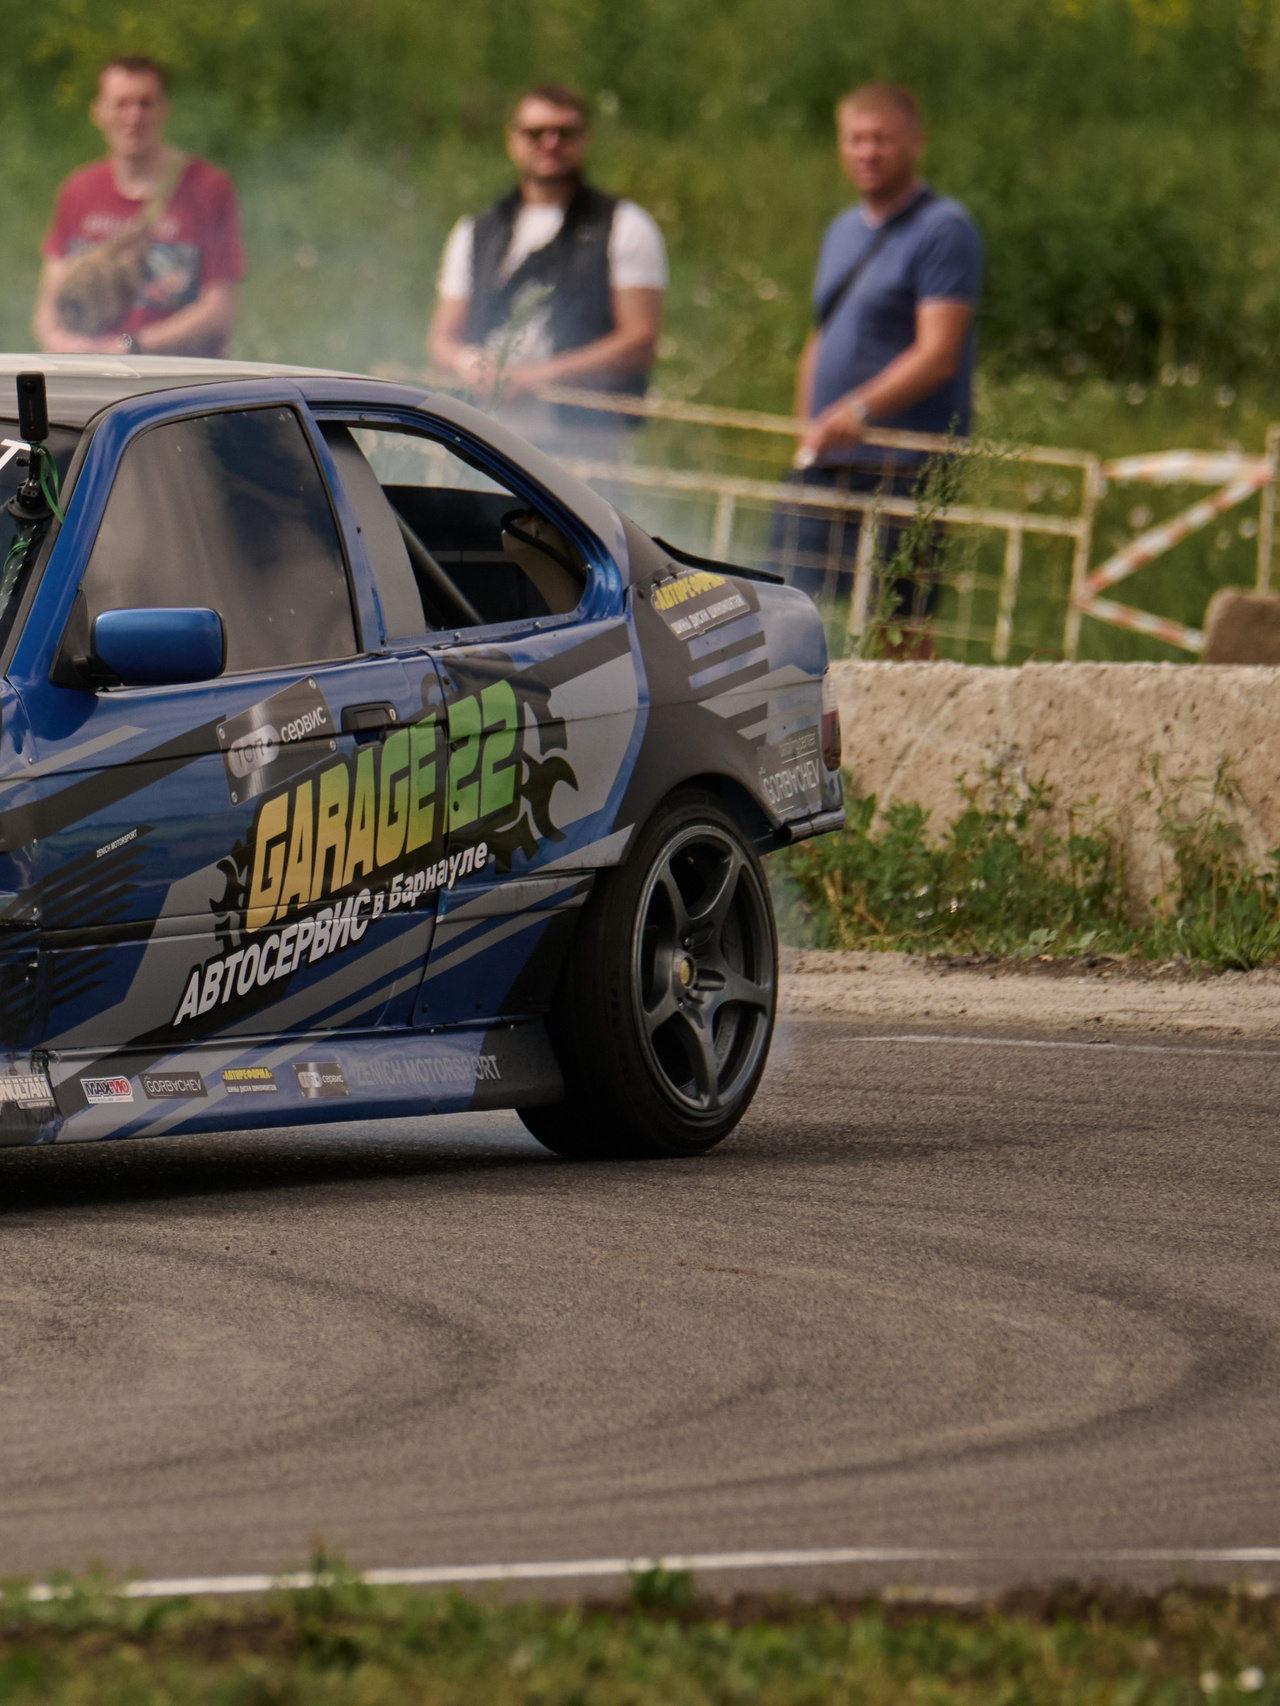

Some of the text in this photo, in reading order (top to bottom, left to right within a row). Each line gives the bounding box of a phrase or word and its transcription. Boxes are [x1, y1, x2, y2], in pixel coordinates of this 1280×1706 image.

[281, 706, 327, 743] сервис
[246, 679, 518, 934] GARAGE 22
[173, 842, 488, 1027] АВТОСЕРВИС в Барнауле
[84, 1078, 130, 1098] MAXMO
[357, 1054, 501, 1086] ZENICH MOTORSPORT
